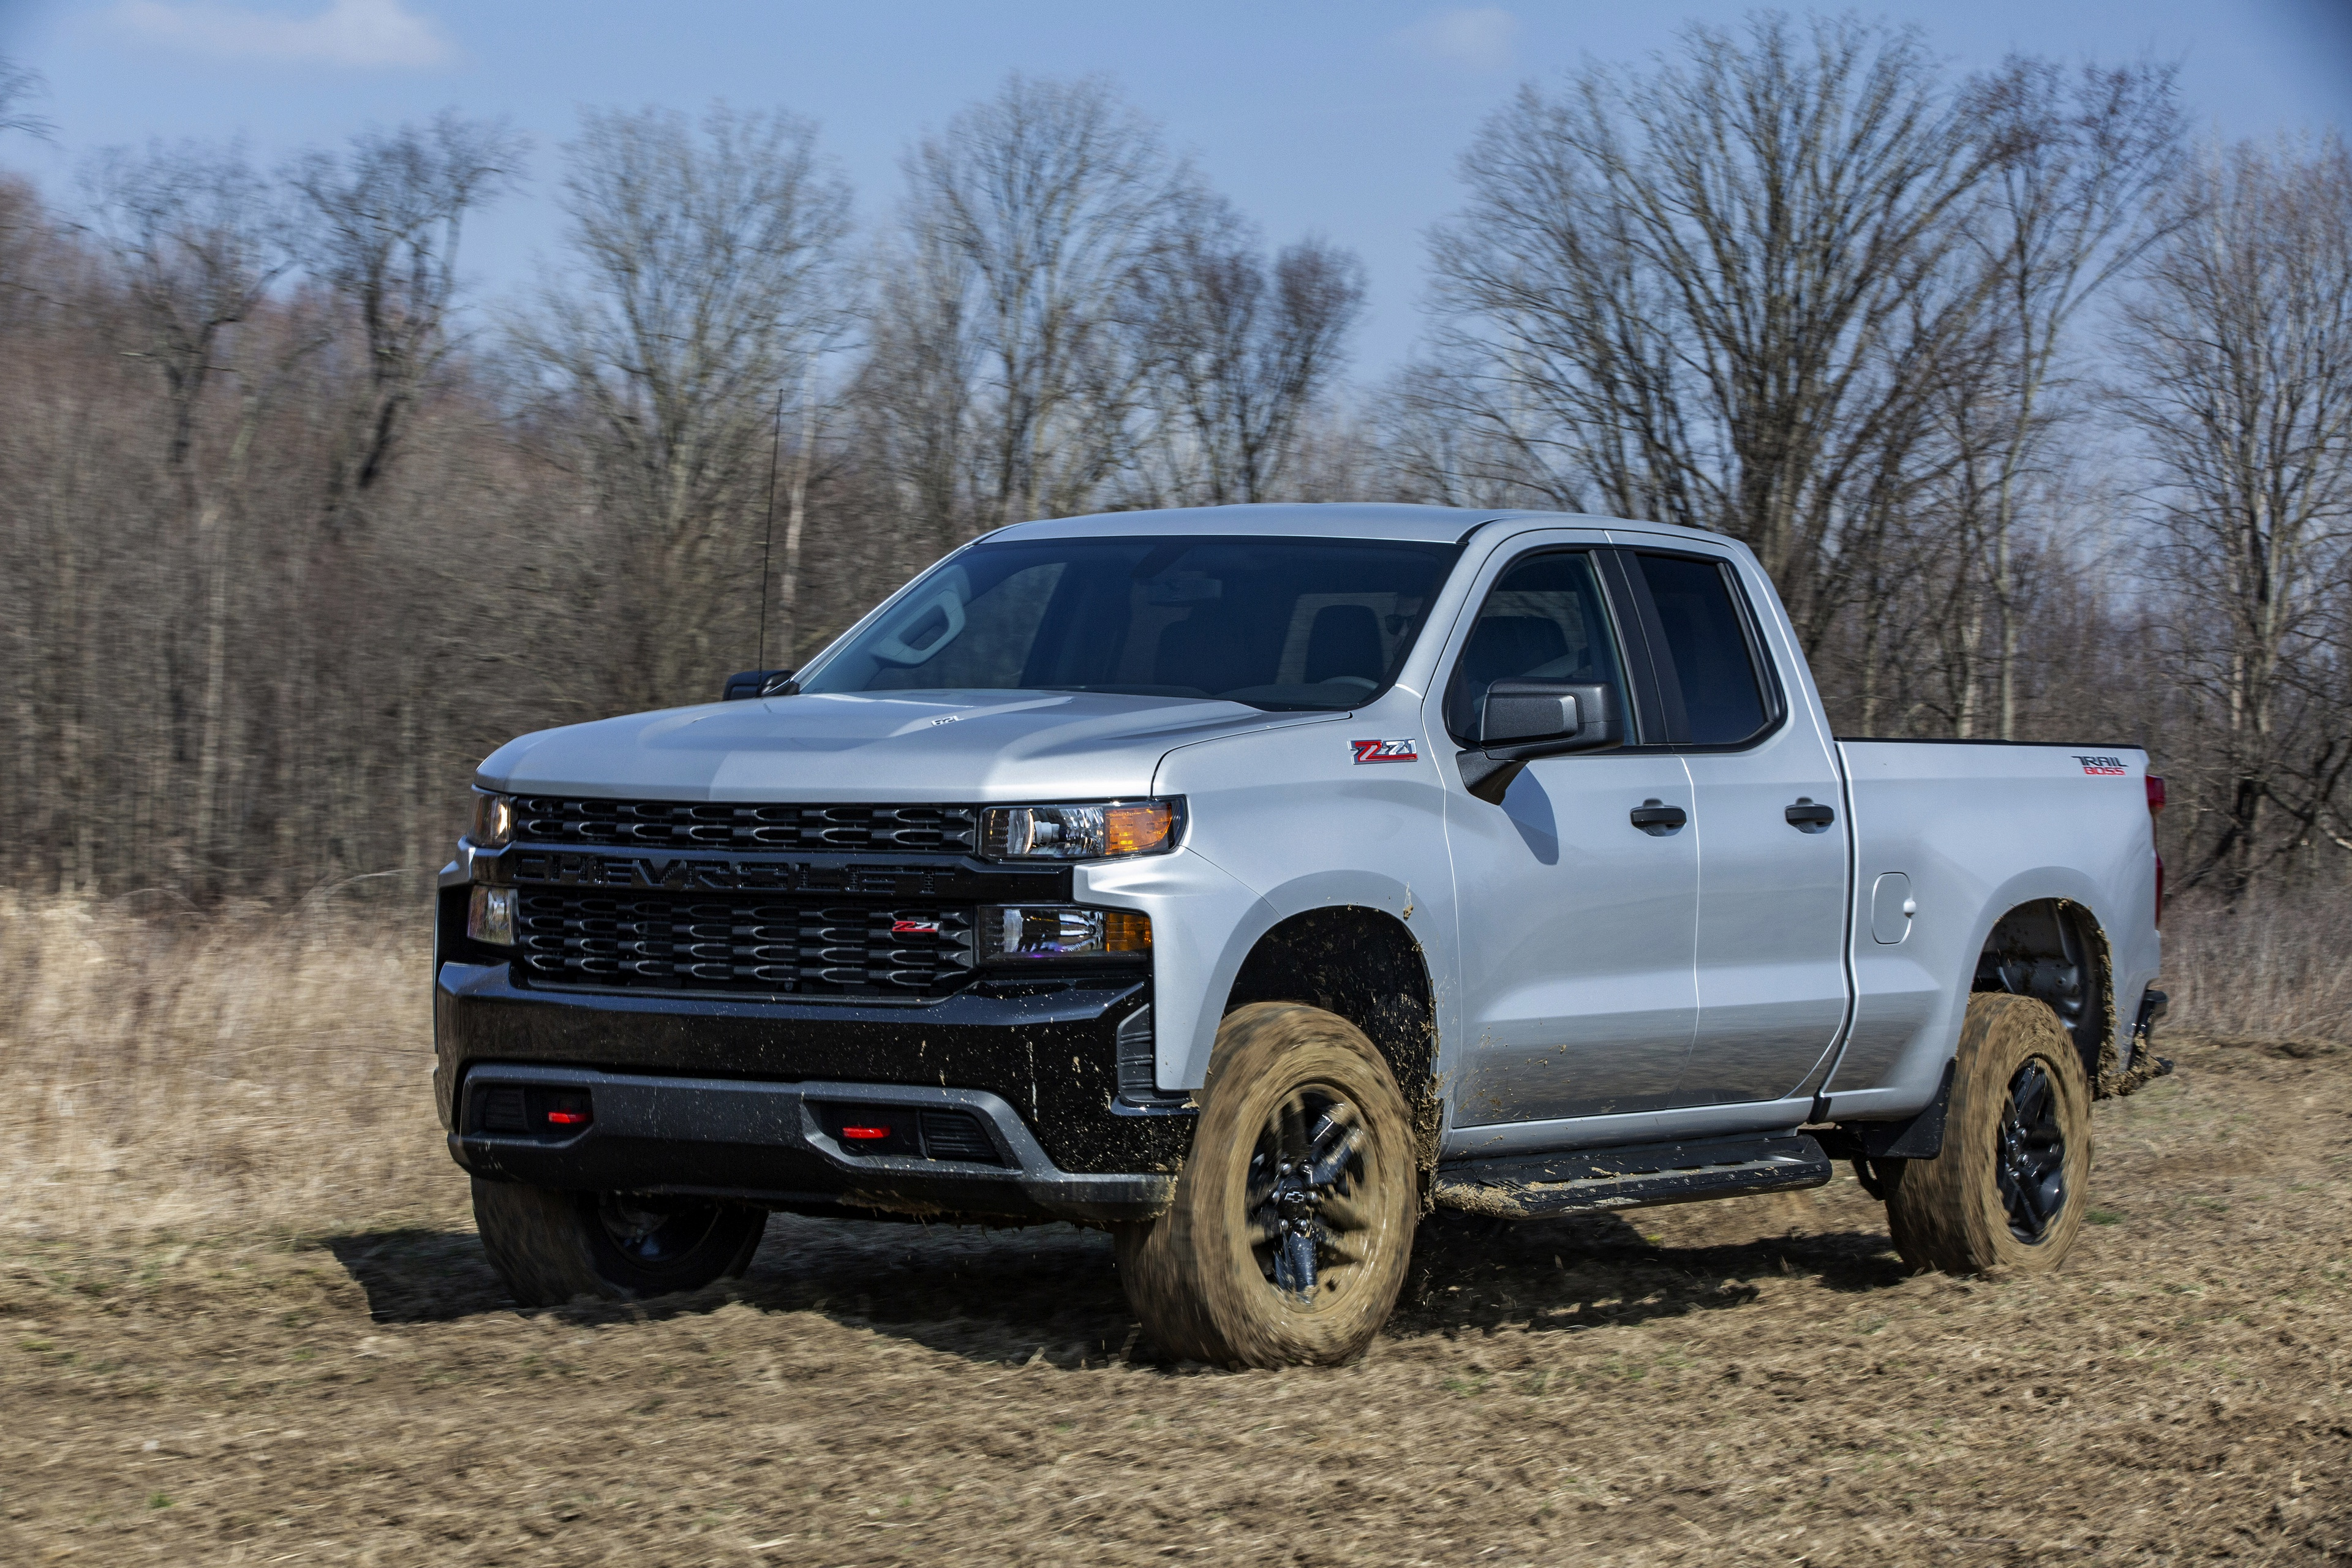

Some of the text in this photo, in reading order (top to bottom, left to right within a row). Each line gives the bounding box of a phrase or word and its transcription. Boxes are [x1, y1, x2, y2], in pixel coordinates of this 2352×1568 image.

[1349, 739, 1418, 764] Z71
[2071, 756, 2128, 767] TRAIL
[2084, 767, 2125, 775] BOSS
[513, 855, 956, 894] CHEVROLET
[892, 921, 940, 932] Z71
[1518, 1161, 1567, 1169] SILVER
